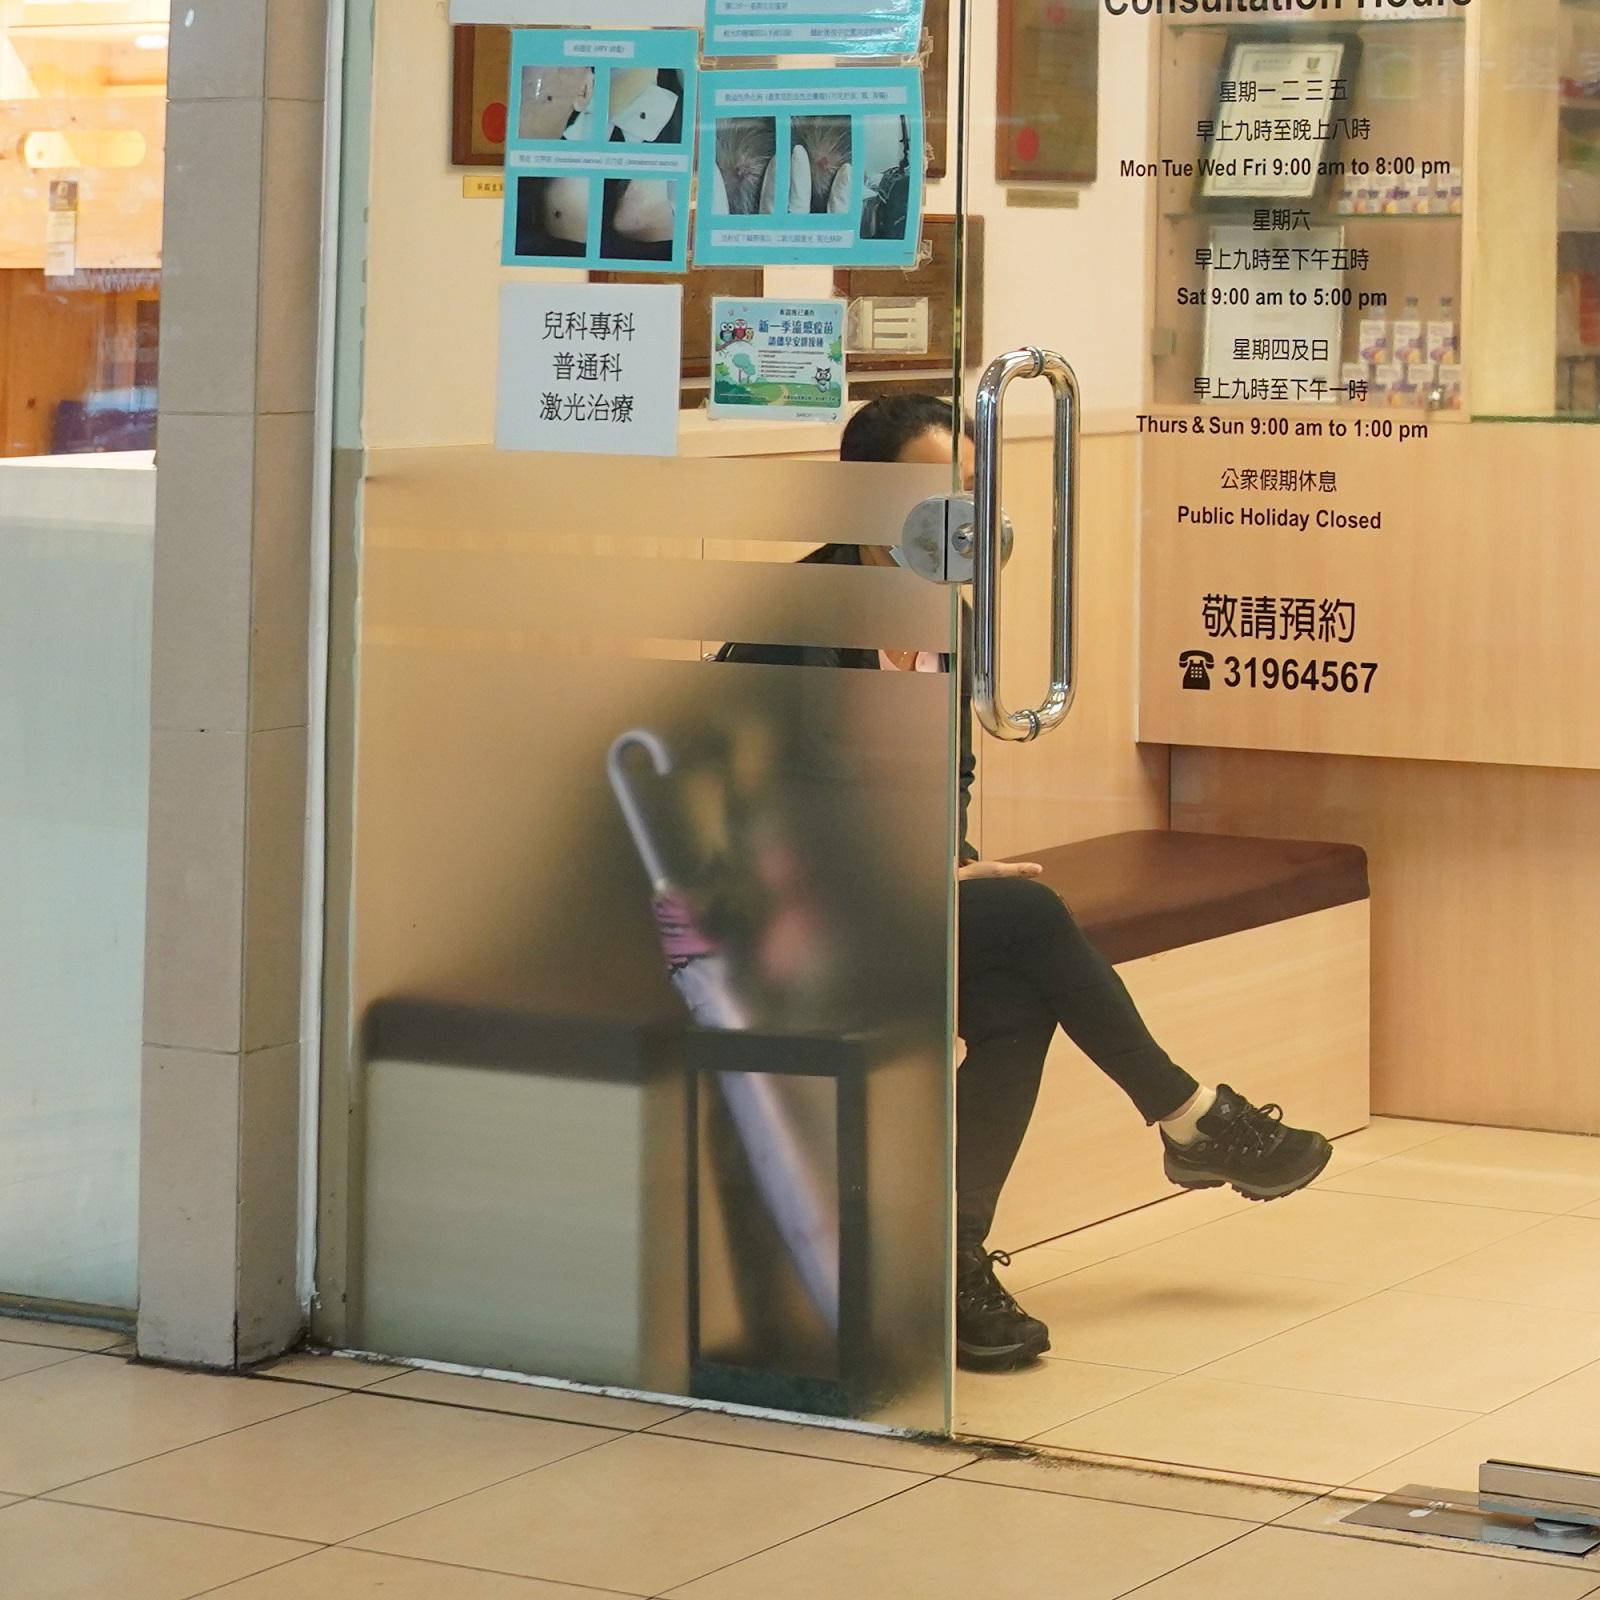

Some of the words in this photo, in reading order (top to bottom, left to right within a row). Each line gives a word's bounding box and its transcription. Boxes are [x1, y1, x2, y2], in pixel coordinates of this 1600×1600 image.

[1196, 118, 1371, 142] 早上九時至晚上八時
[1120, 159, 1157, 177] Mon
[1162, 159, 1193, 176] Tue
[1198, 158, 1236, 176] Wed
[1243, 158, 1267, 176] Fri
[1272, 157, 1311, 176] 9:00
[1317, 161, 1345, 175] am
[1351, 158, 1370, 175] to
[1375, 157, 1416, 175] 8:00
[1421, 161, 1451, 180] pm
[1252, 209, 1311, 231] 星期六
[1195, 248, 1369, 271] 早上九時至下午五時
[1177, 287, 1207, 305] Sat
[1211, 287, 1250, 306] 9:00
[1255, 291, 1284, 306] am
[1289, 288, 1308, 306] to
[1313, 287, 1353, 306] 5:00
[1358, 292, 1388, 310] pm
[544, 311, 635, 341] 兒科專科
[758, 320, 833, 335] 新一季流感疫苗
[1232, 338, 1329, 362] 星期四及日
[552, 352, 622, 382] 普通科
[1193, 377, 1368, 401] 早上九時至下午一時
[539, 392, 634, 424] 激光治療
[1136, 415, 1188, 434] Thurs
[1192, 417, 1205, 434] &
[1209, 417, 1245, 435] Sun
[1250, 418, 1289, 436] 9:00
[1294, 422, 1323, 437] am
[1329, 419, 1347, 437] to
[1353, 419, 1393, 438] 1:00
[1399, 423, 1429, 442] pm
[1177, 505, 1235, 526] Public
[1240, 507, 1310, 531] Holiday
[1316, 509, 1382, 530] Closed
[1202, 593, 1356, 643] 敬請預約
[1224, 657, 1379, 694] 31964567
